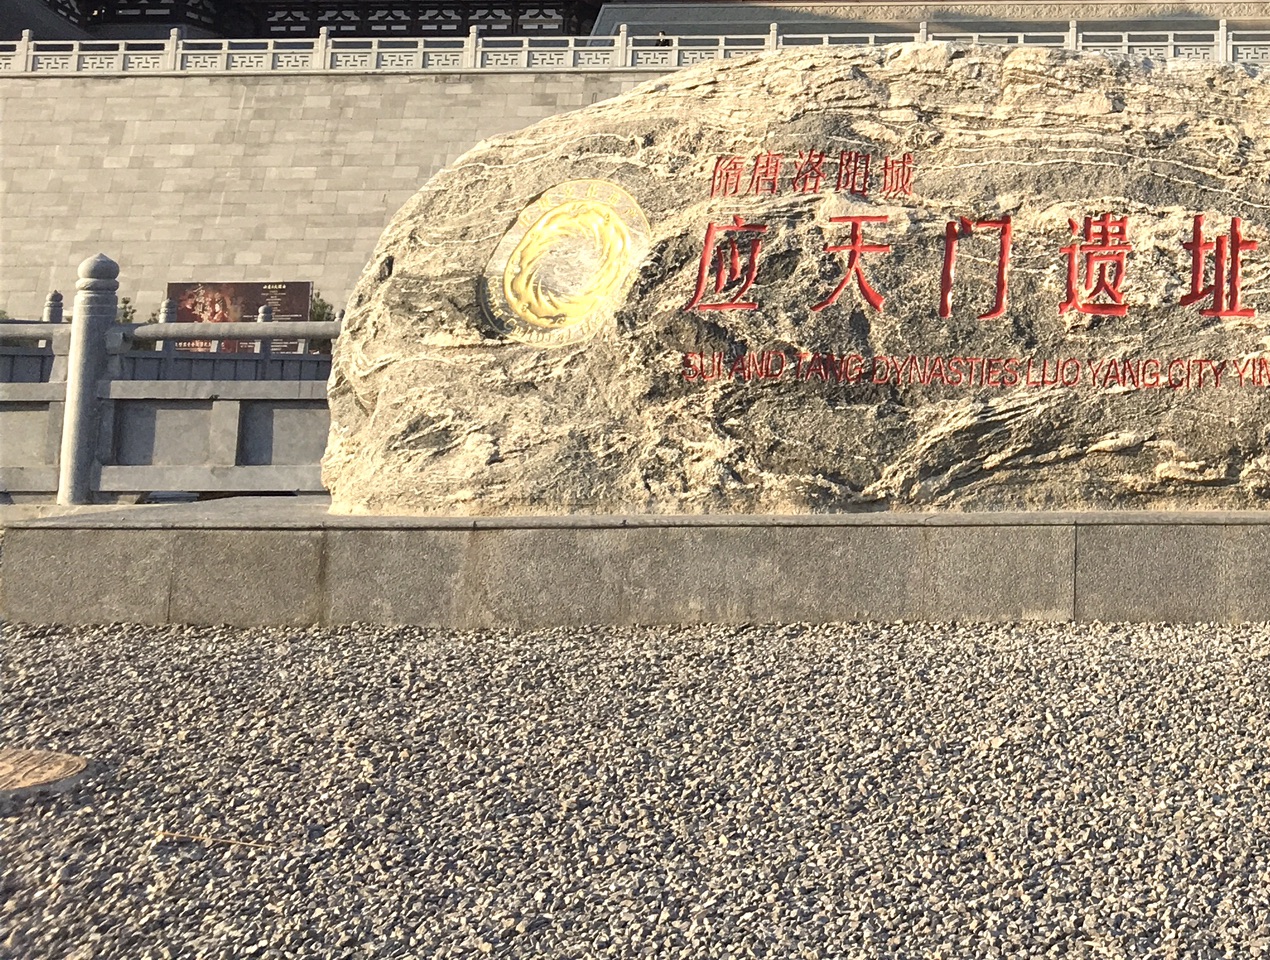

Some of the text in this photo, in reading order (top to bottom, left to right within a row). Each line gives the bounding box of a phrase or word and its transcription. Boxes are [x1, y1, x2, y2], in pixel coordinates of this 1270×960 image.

[710, 149, 914, 199] 隋唐洛阳城
[682, 351, 724, 381] SUI
[728, 351, 786, 380] AND
[795, 351, 864, 382] TANG
[872, 355, 1020, 387] DYNASTIES
[1026, 358, 1082, 387] LUO
[1088, 358, 1161, 388] YANG
[1168, 358, 1226, 390] CITY
